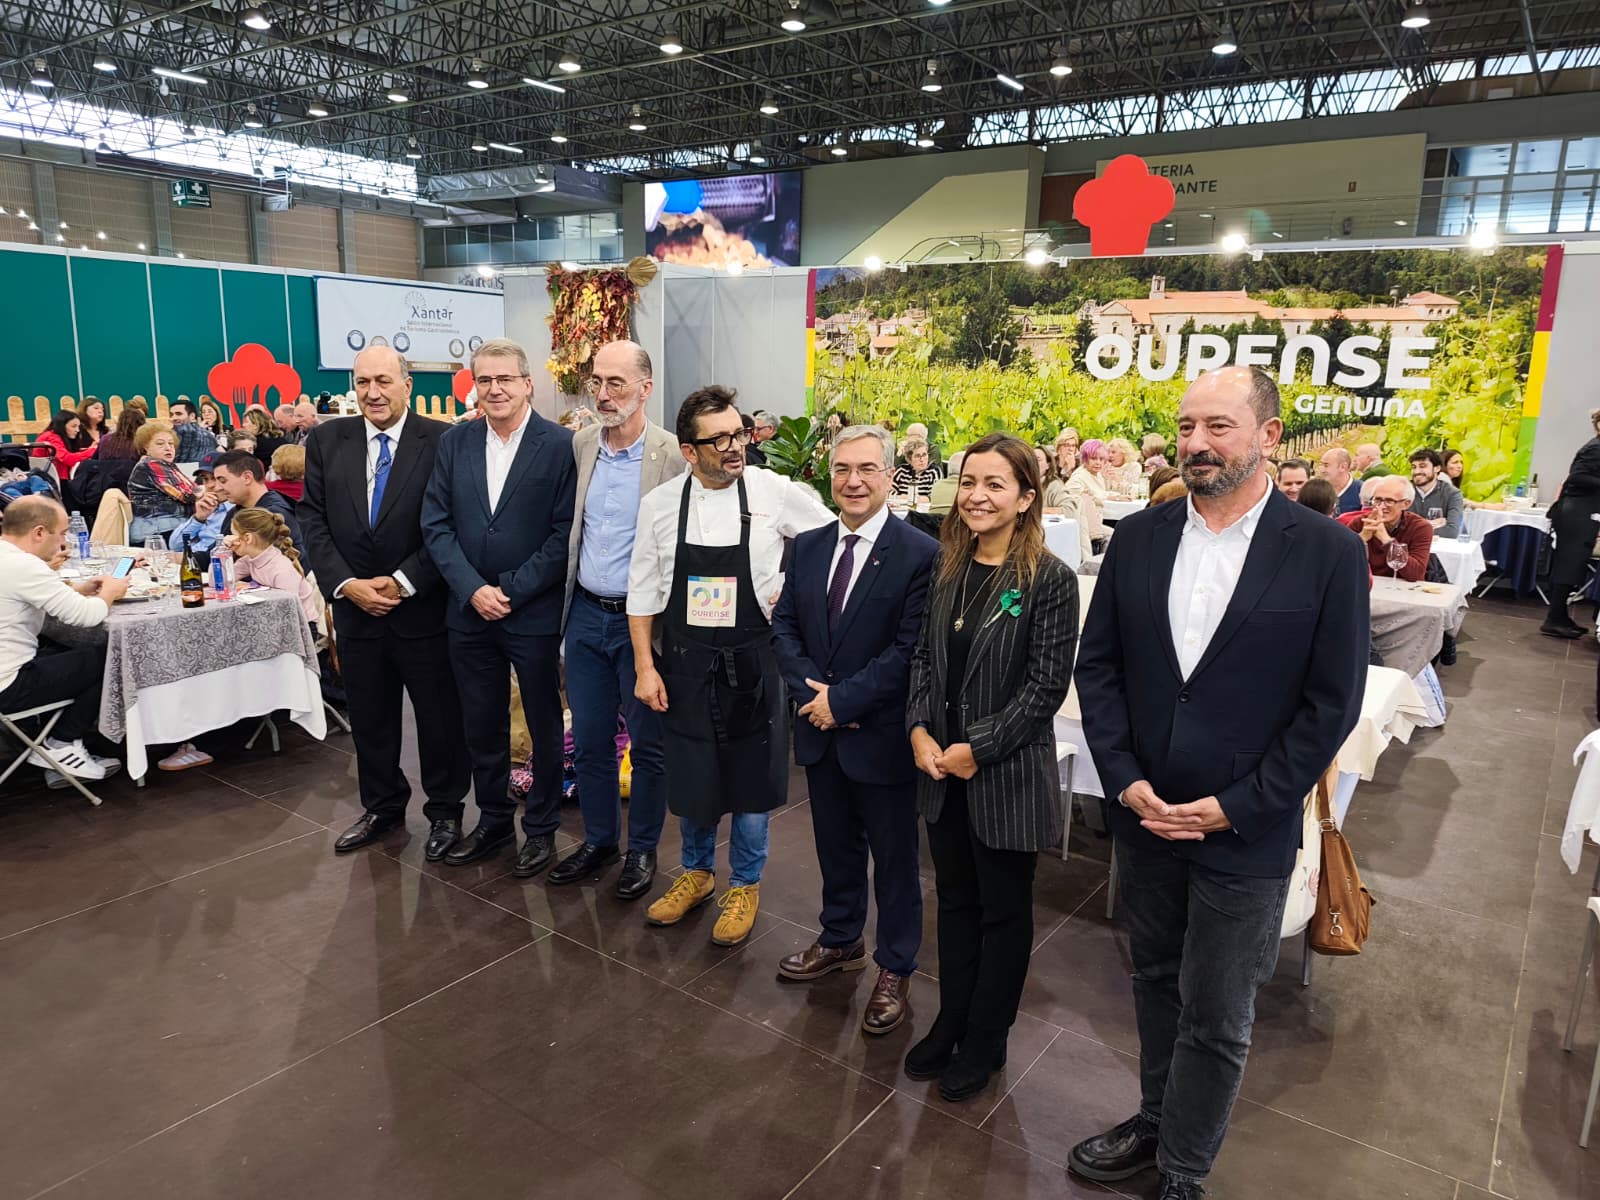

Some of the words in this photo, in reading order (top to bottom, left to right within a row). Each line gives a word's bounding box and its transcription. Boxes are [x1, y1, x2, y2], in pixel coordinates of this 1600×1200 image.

[1148, 164, 1194, 177] TERIA
[1173, 180, 1217, 194] ANTE
[1085, 333, 1440, 389] OURENSE
[1294, 395, 1426, 418] GENUINA
